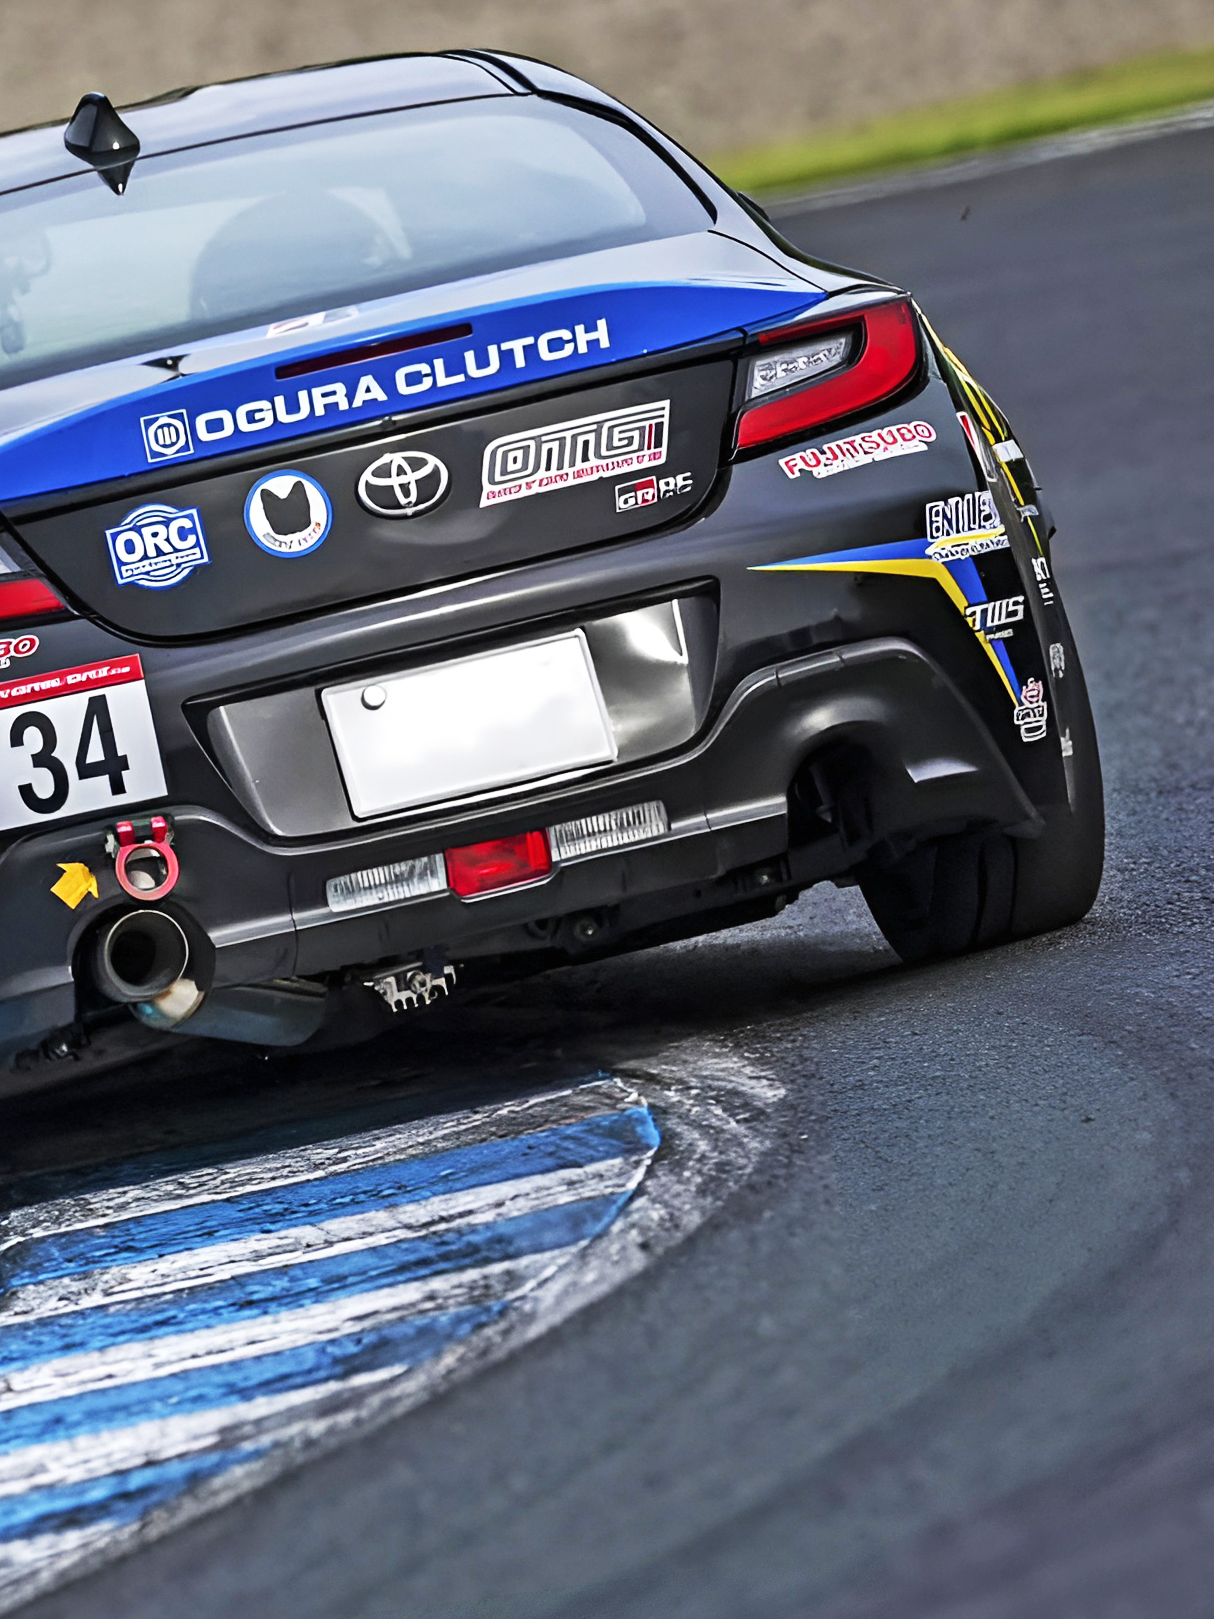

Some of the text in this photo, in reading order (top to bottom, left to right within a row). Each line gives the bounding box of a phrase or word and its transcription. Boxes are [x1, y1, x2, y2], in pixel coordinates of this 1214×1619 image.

[195, 318, 611, 442] OGURA CLUTCH
[778, 421, 936, 479] FUJITSUBO
[114, 517, 197, 564] ORC
[965, 595, 1025, 631] TWS
[9, 693, 130, 815] 34
